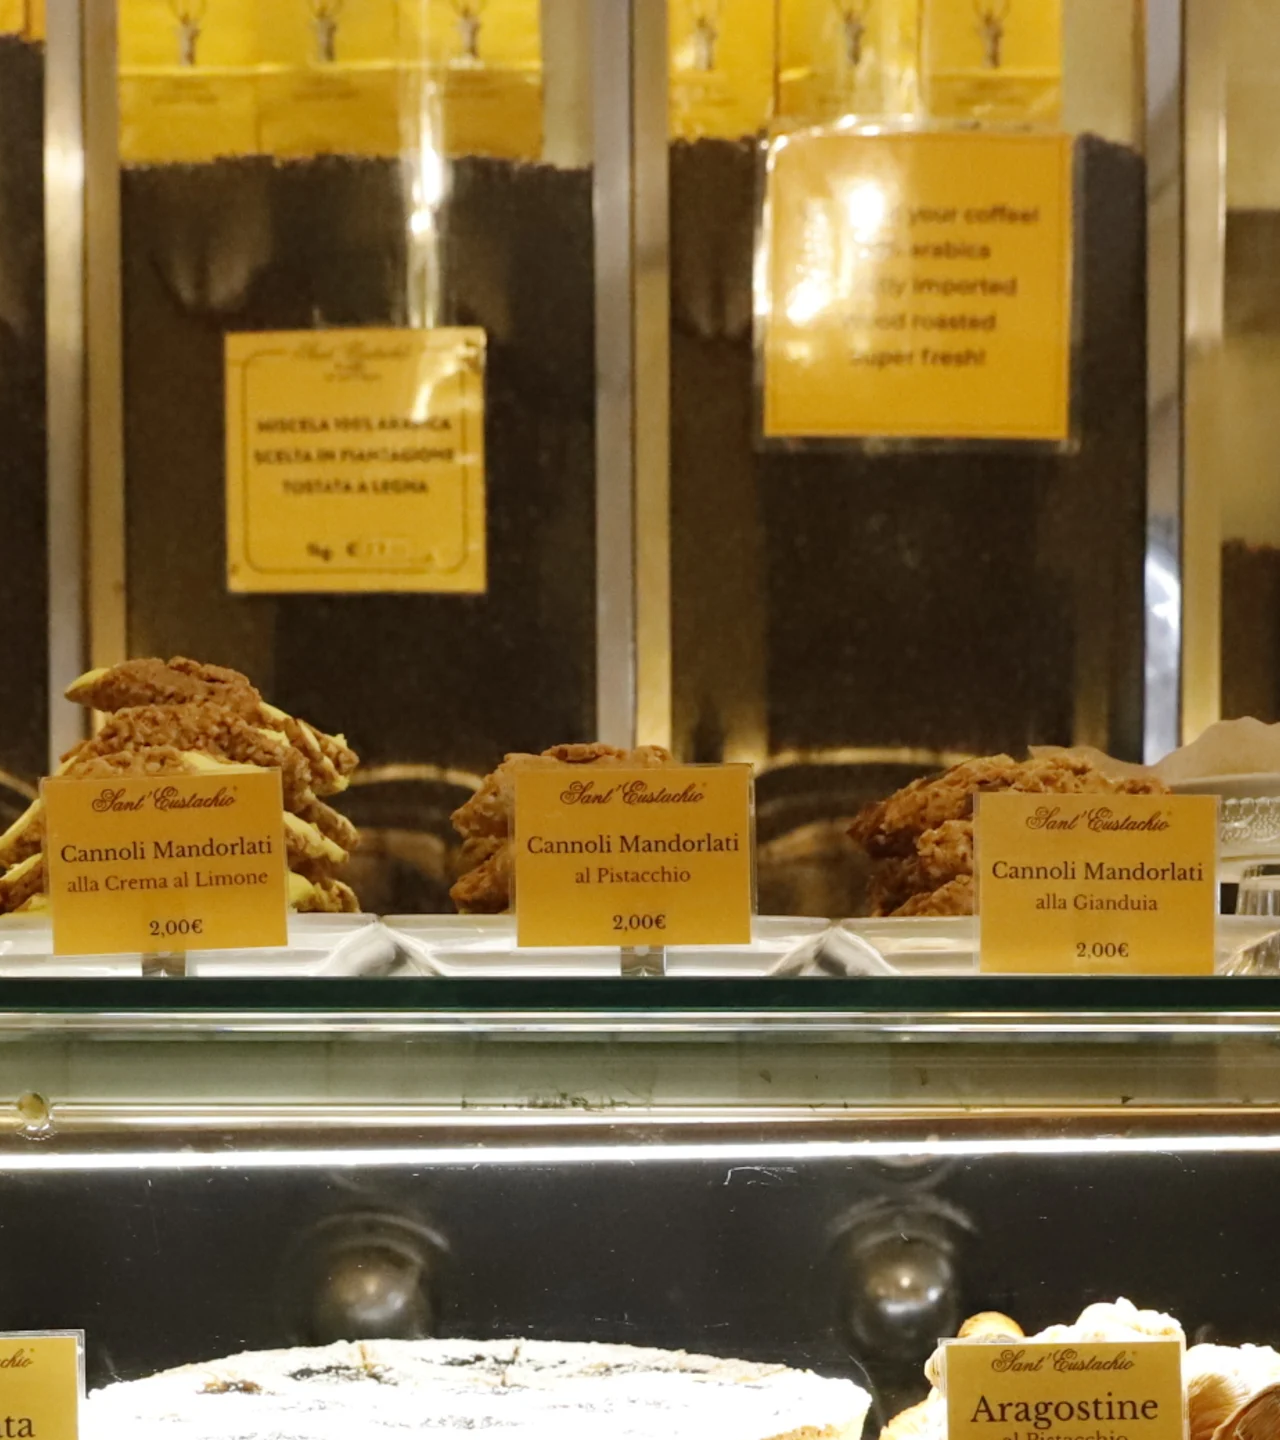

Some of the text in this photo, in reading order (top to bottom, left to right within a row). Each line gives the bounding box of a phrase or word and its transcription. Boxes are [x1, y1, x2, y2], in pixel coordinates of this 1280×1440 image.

[60, 836, 272, 863] Cannoli Mandorlati
[527, 833, 740, 855] Cannoli Mandorlati
[67, 870, 269, 893] alla Crema al Limone
[575, 867, 692, 885] al Pistacchio
[992, 860, 1204, 882] Cannoli Mandorlati
[1035, 893, 1159, 911] alla Gianduia
[149, 919, 203, 939] 2,00€
[613, 914, 666, 932] 2,00€
[1076, 942, 1130, 959] 2,00€
[970, 1392, 1160, 1430] Aragostine
